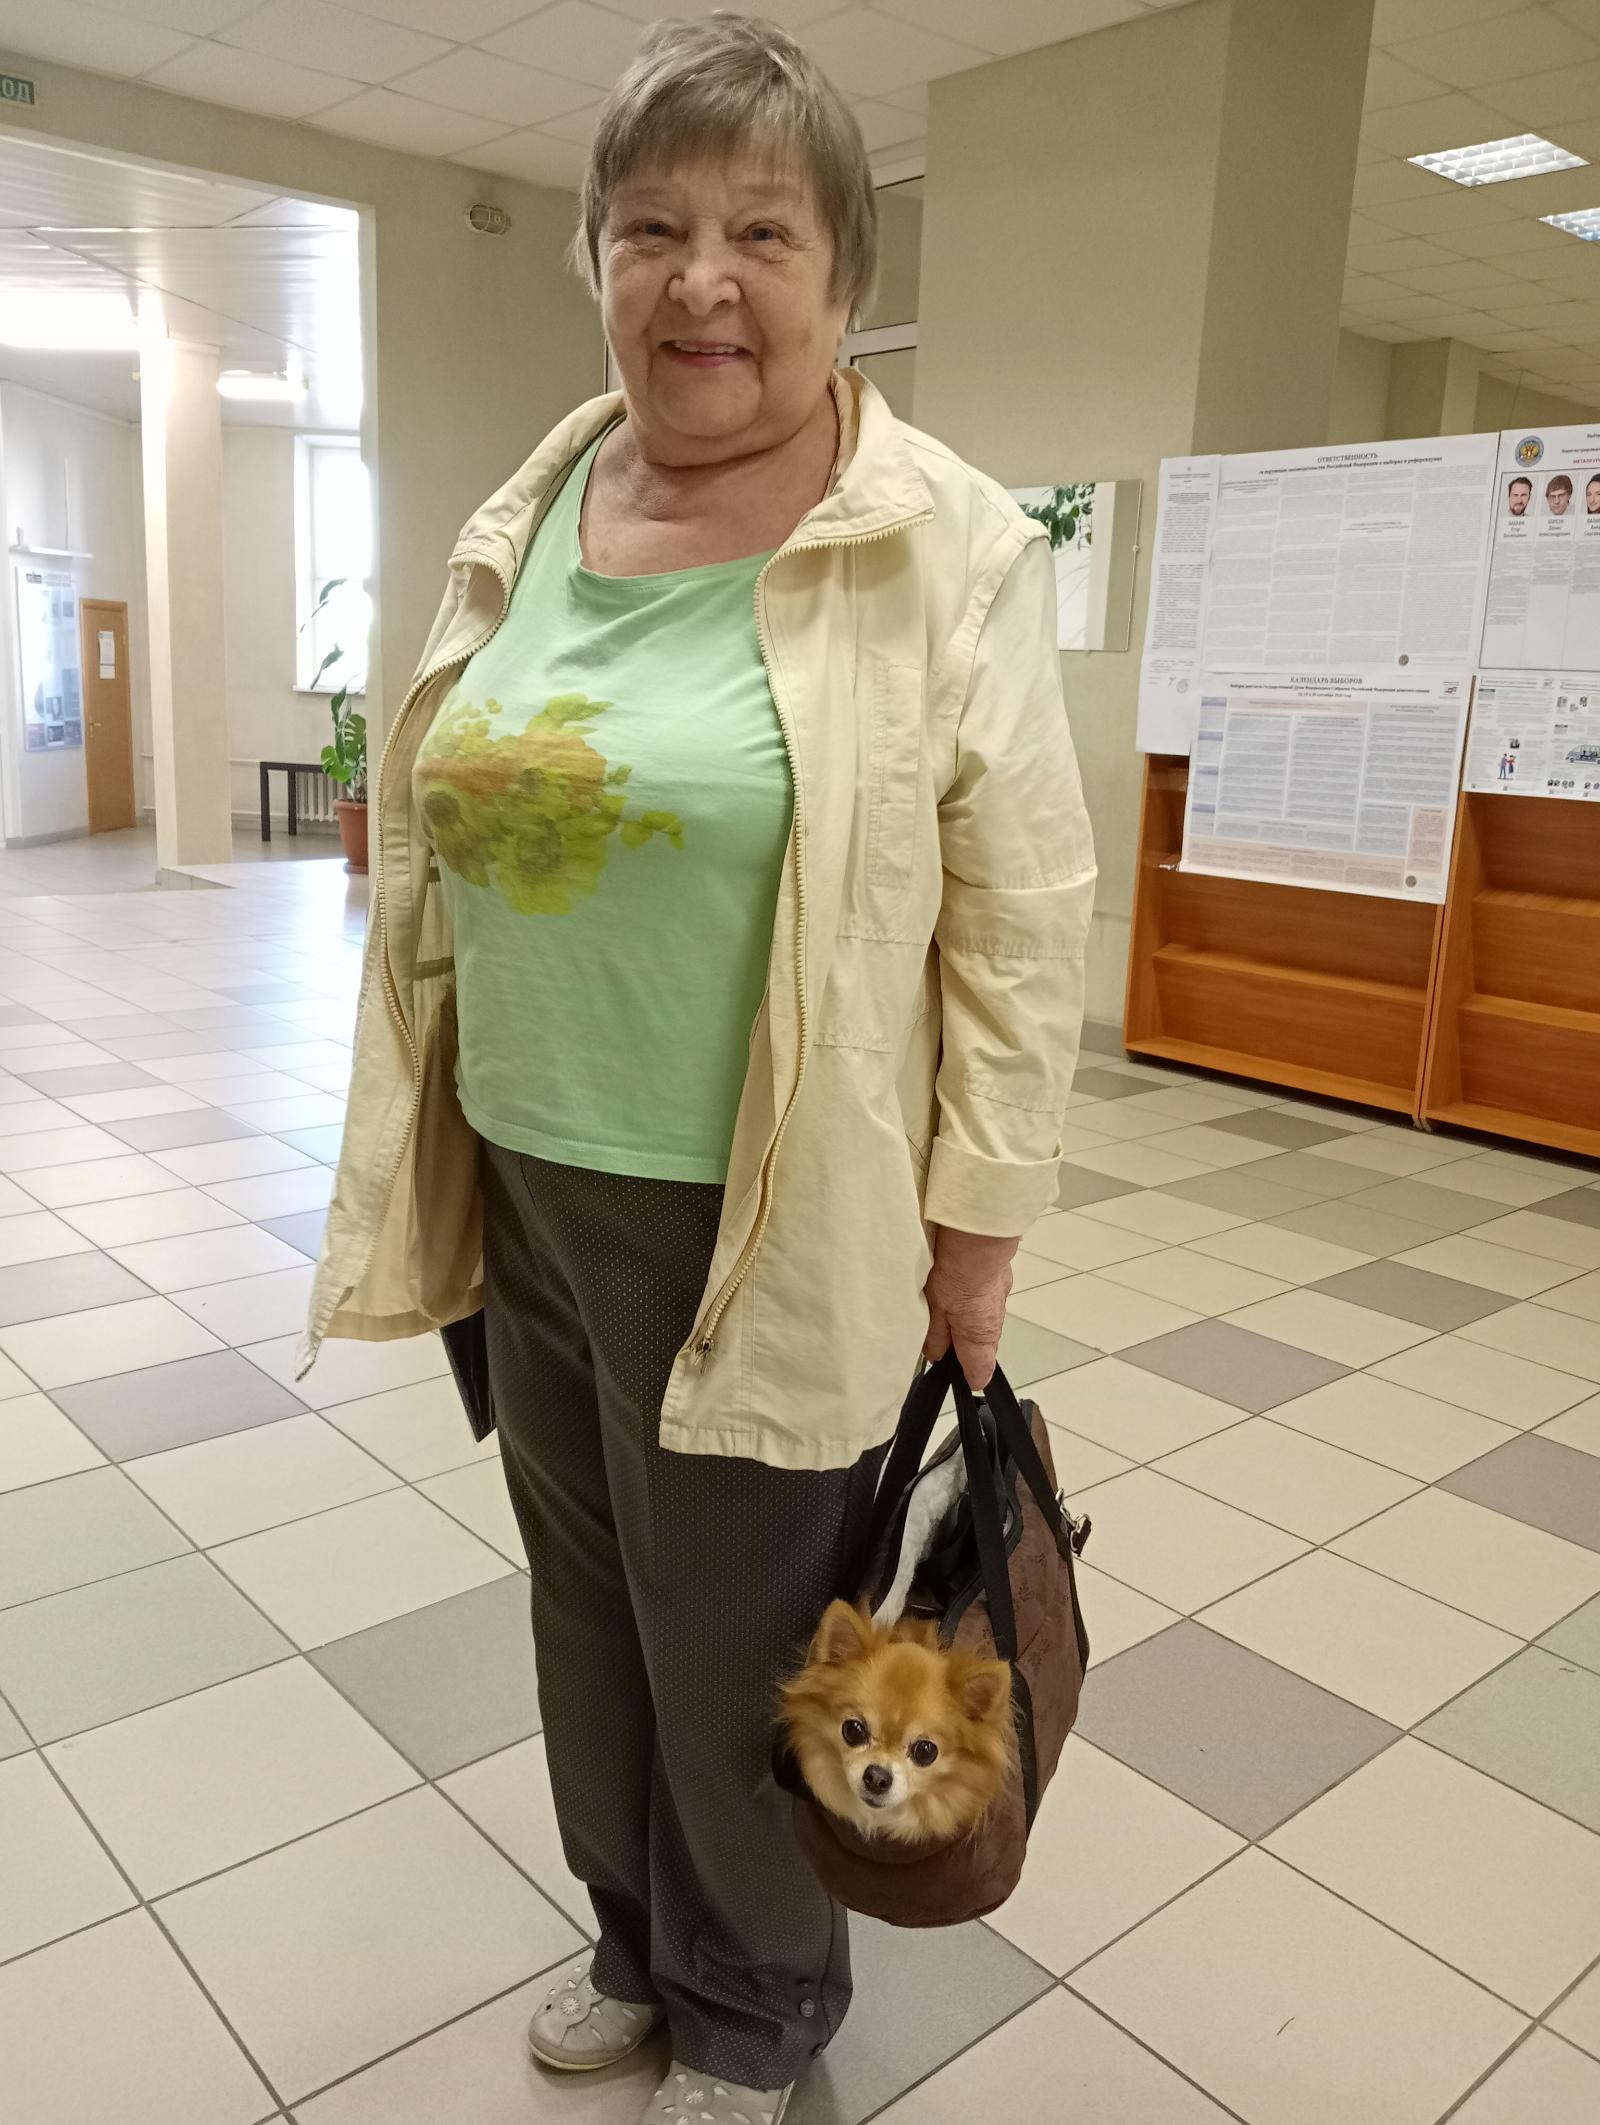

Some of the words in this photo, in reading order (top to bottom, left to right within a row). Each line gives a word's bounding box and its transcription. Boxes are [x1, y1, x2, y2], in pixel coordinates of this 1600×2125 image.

[1317, 453, 1378, 463] ОТВЕТСТВЕННОСТЬ
[1290, 676, 1329, 684] КАЛЕНДАРЬ
[1330, 677, 1363, 685] ВЫБОРОВ
